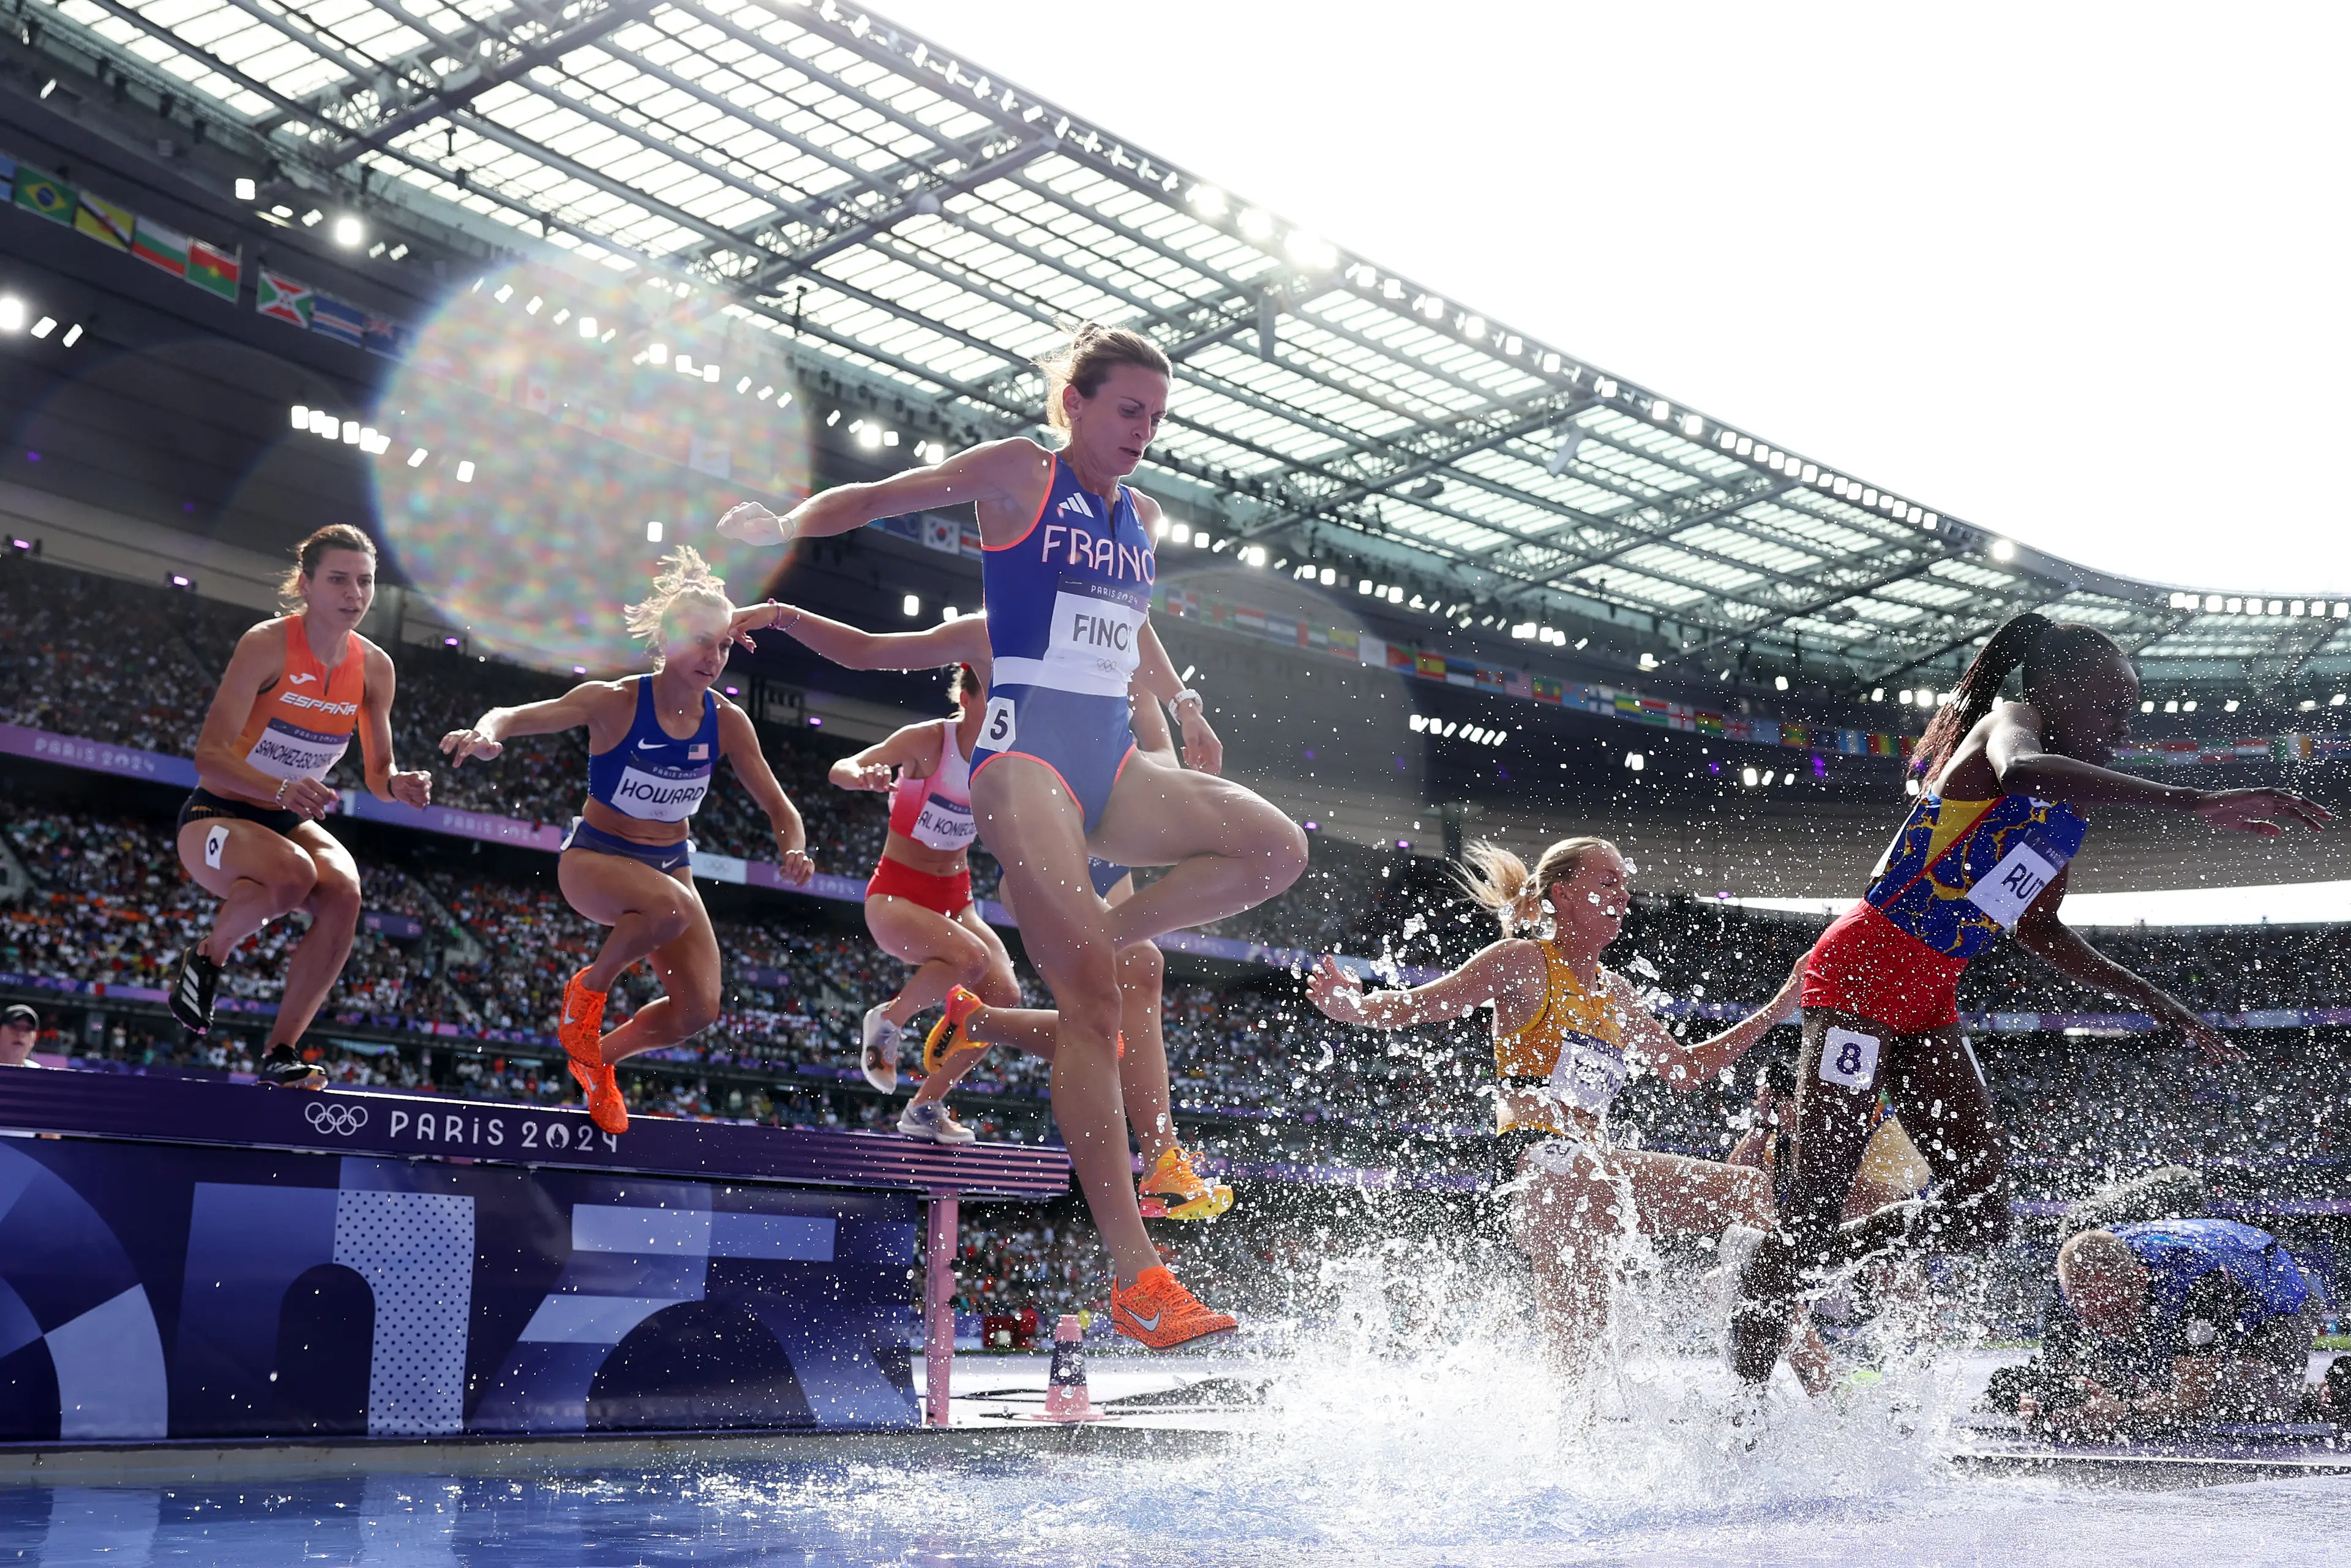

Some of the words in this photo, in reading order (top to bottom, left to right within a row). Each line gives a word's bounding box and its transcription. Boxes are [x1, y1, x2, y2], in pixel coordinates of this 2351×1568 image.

[1117, 591, 1139, 606] 2024
[279, 691, 358, 716] ESPAÑA
[990, 708, 1009, 740] 5
[620, 778, 705, 805] HOWARD
[918, 810, 932, 830] AL
[1835, 1042, 1862, 1075] 8
[520, 1120, 618, 1153] 2024
